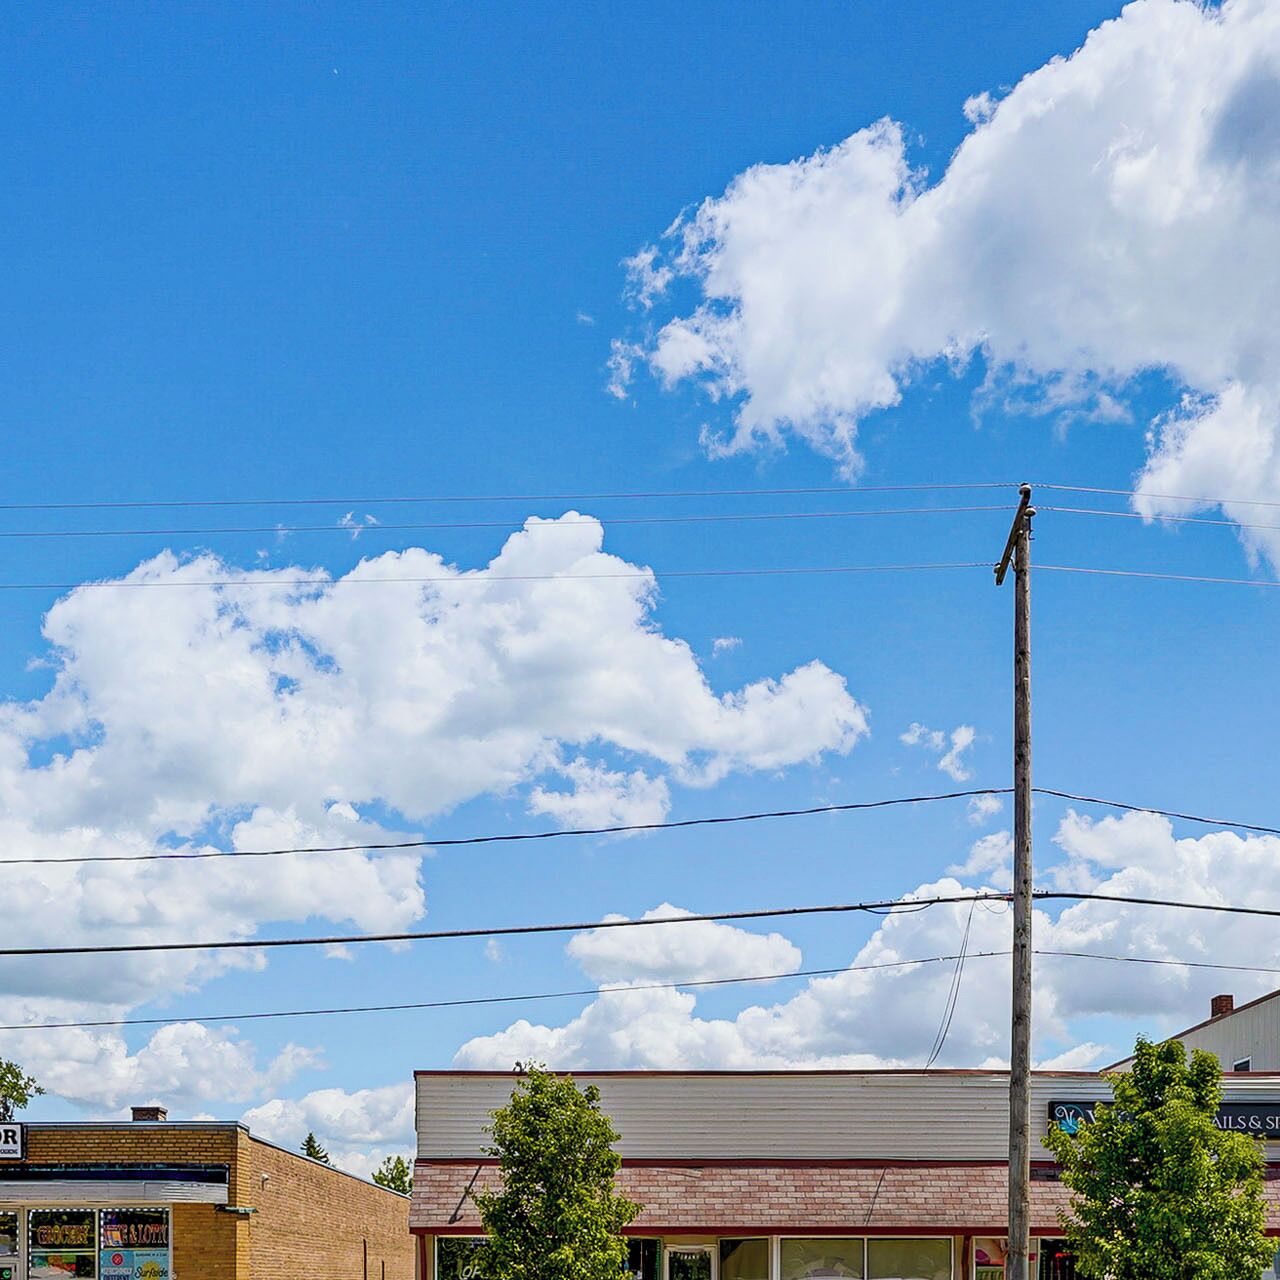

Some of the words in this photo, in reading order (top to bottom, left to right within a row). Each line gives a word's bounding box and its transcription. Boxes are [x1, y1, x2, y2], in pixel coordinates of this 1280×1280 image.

[1212, 1115, 1246, 1129] AILS
[1248, 1115, 1262, 1129] &
[135, 1266, 168, 1279] Surfside
